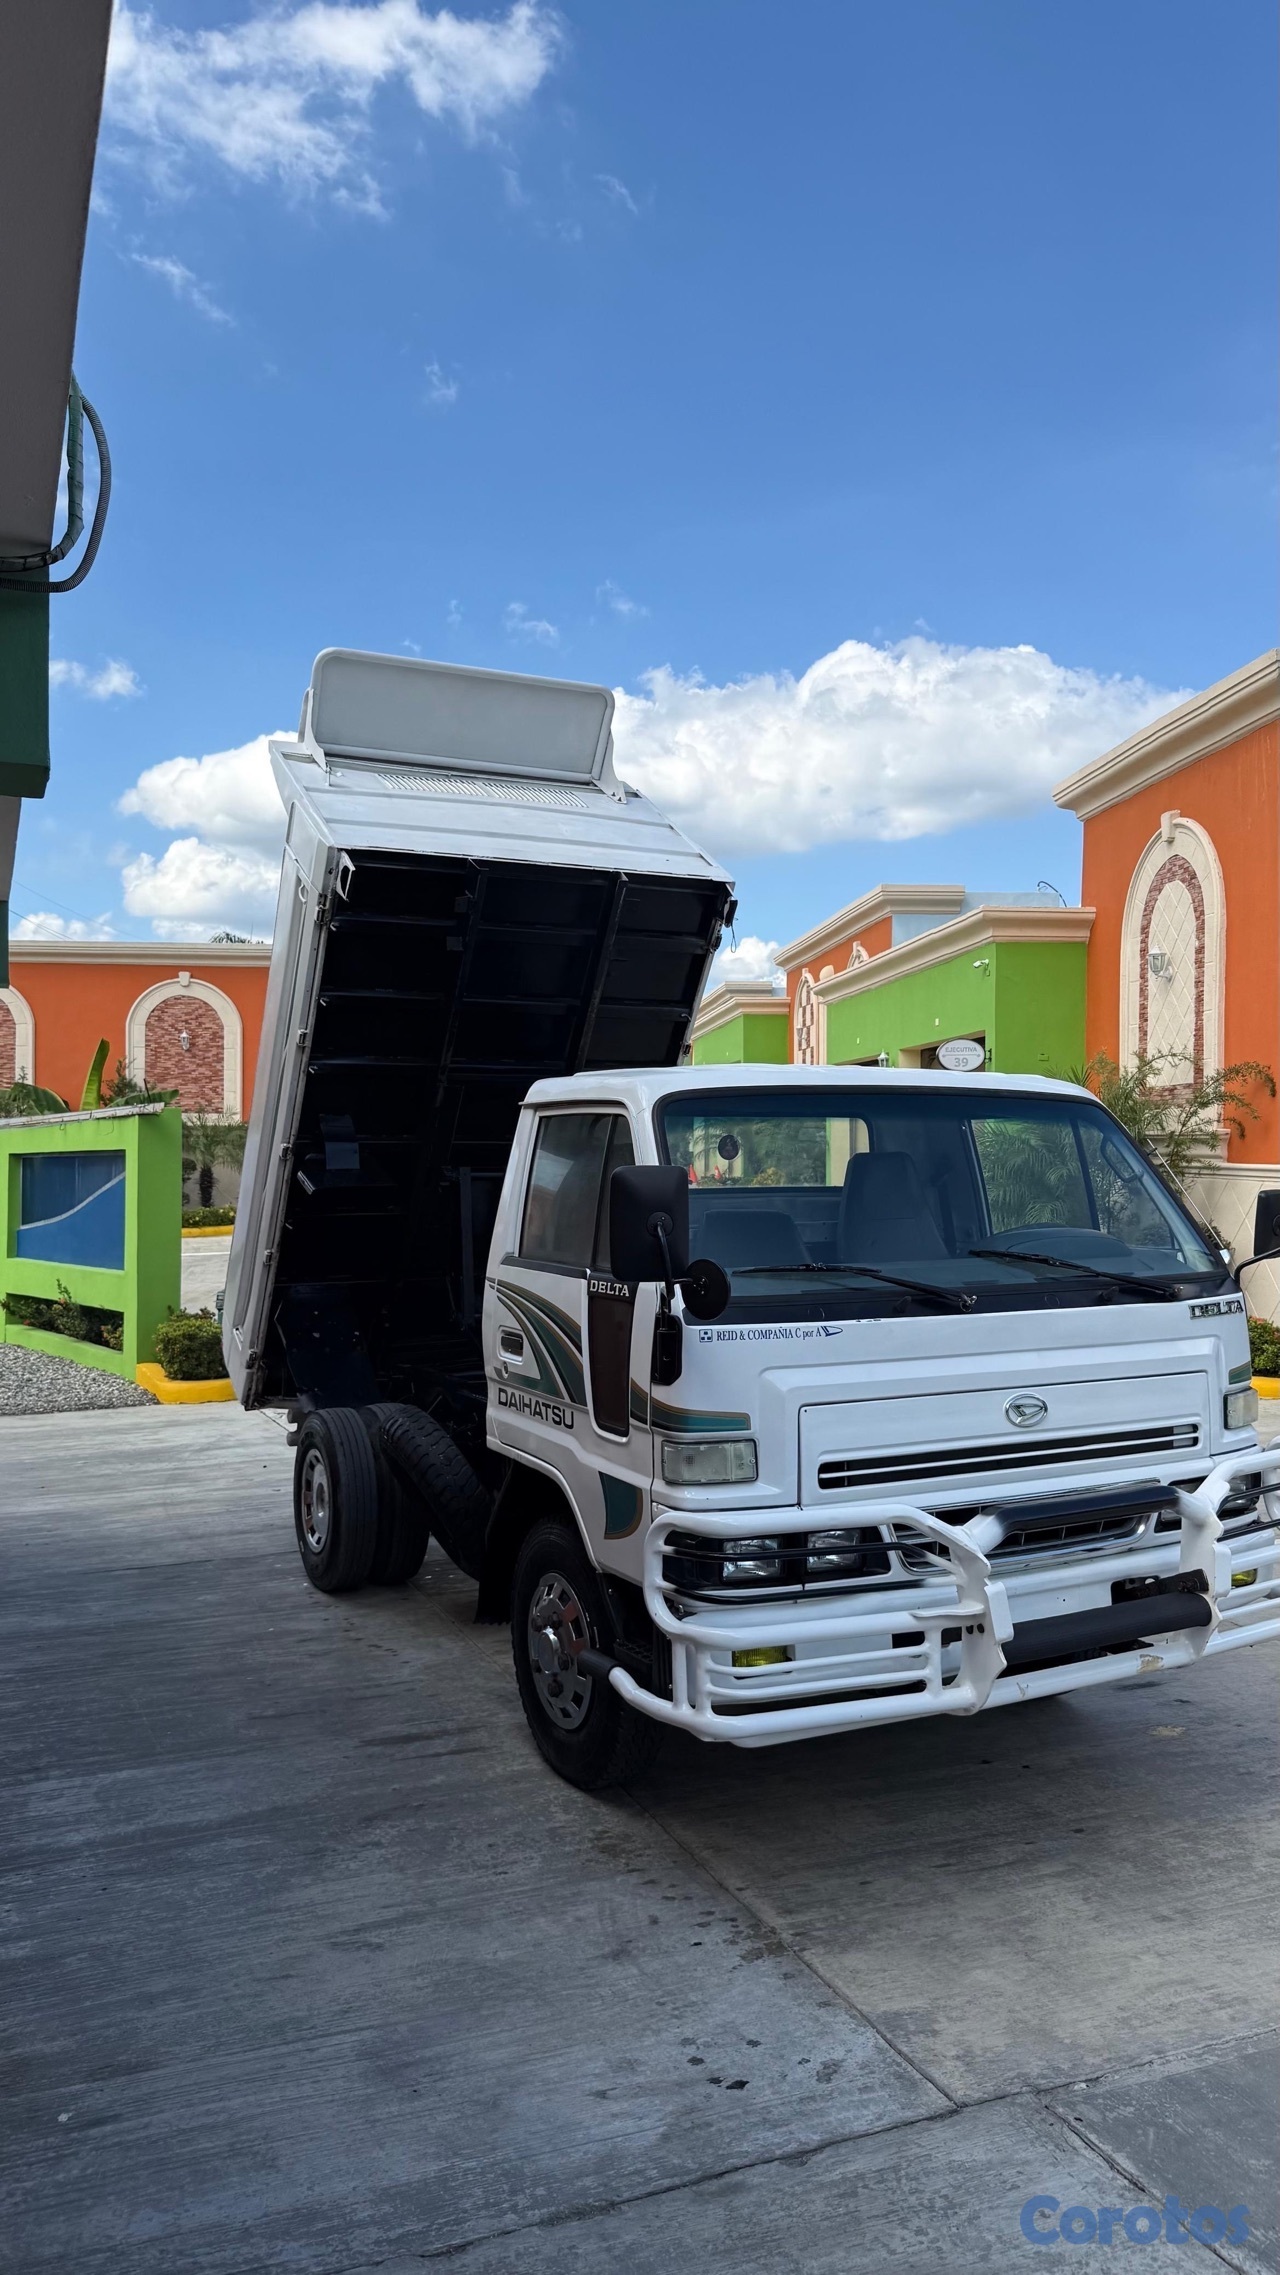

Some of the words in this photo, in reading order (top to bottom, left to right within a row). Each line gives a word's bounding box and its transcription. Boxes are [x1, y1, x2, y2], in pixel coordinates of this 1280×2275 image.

[954, 1057, 968, 1067] 39
[590, 1280, 630, 1297] DELTA
[1188, 1300, 1244, 1320] DELTA
[716, 1330, 738, 1341] REID
[740, 1331, 746, 1340] &
[747, 1326, 794, 1341] COMPAÑIA
[795, 1327, 801, 1338] C
[802, 1330, 814, 1340] por
[815, 1327, 822, 1337] A
[498, 1387, 574, 1429] DAIHATSU
